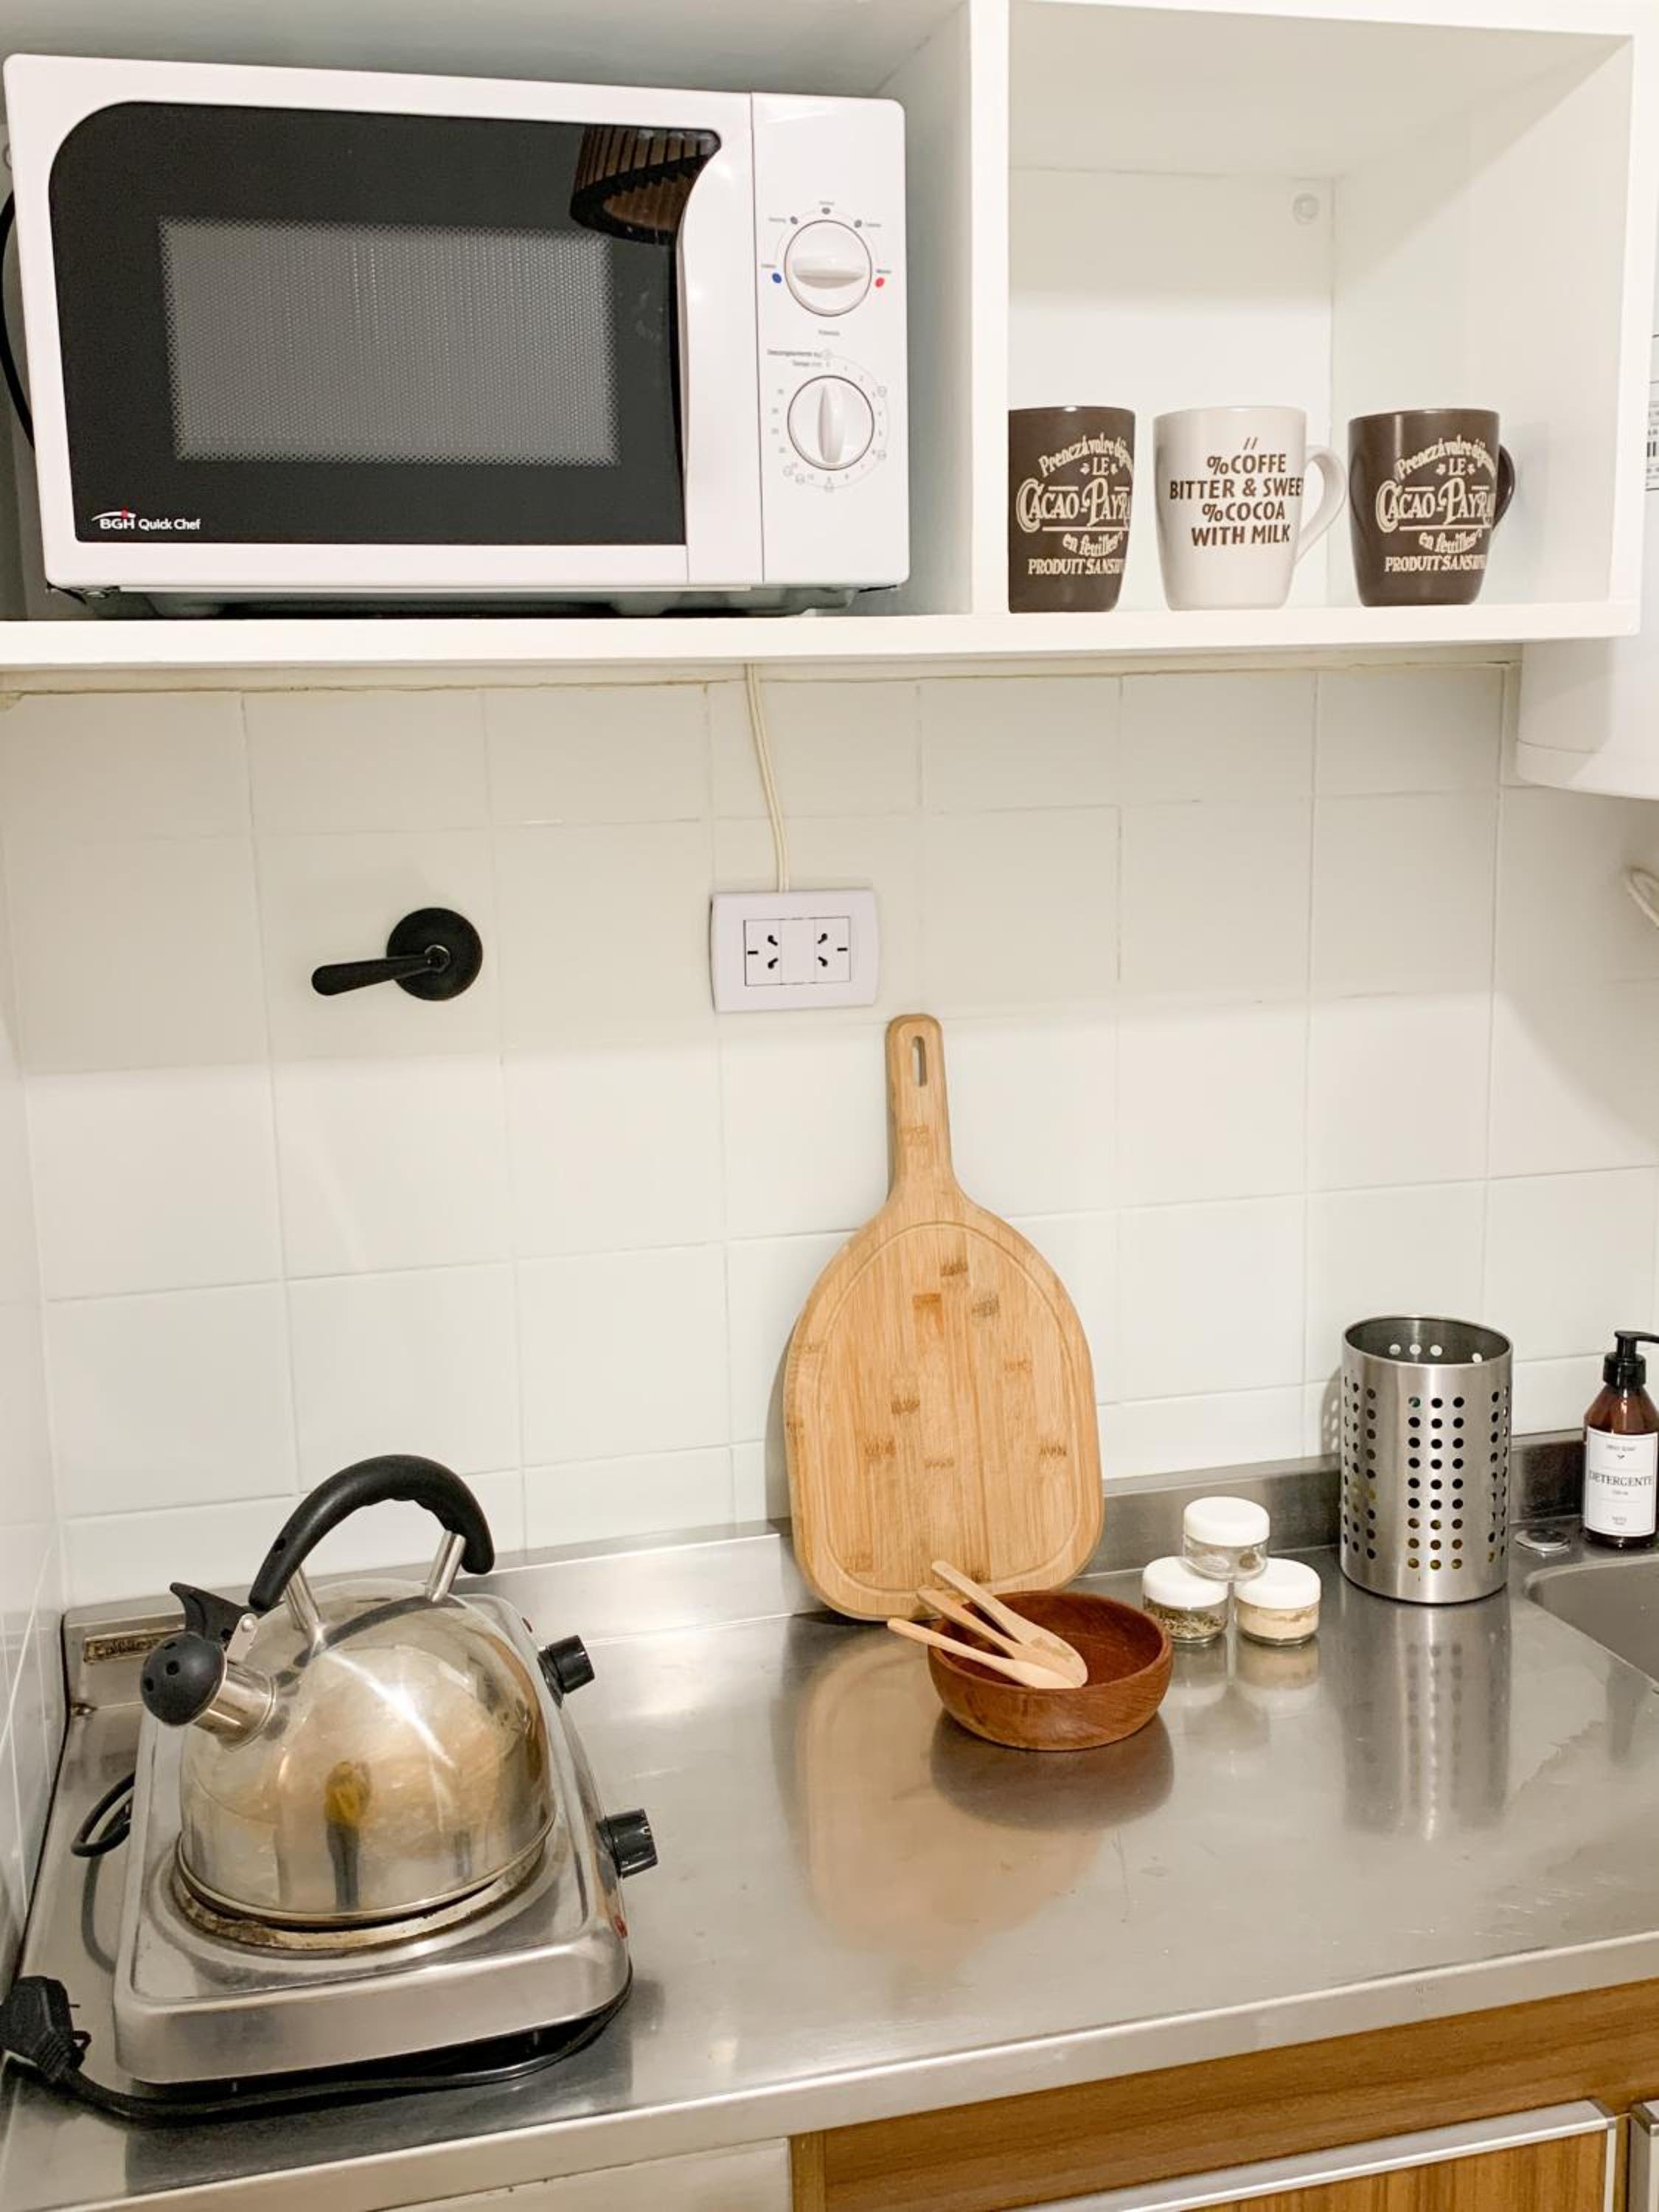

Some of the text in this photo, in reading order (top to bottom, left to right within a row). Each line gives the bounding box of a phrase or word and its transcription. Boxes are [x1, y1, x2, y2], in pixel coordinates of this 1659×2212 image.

[1092, 457, 1110, 476] LE
[1206, 453, 1287, 475] %COFFE
[1448, 458, 1467, 476] LE
[1169, 477, 1304, 500] BITTER & SWEE
[1202, 501, 1285, 523] %COCOA
[100, 518, 201, 531] BGH Quick Chef
[1062, 532, 1079, 553] en
[1192, 524, 1291, 546] WITH MILK
[1419, 532, 1434, 551] en
[1027, 558, 1085, 575] PRODUIT
[1384, 555, 1441, 572] PRODUIT
[1588, 1470, 1653, 1487] DETERGENTE
